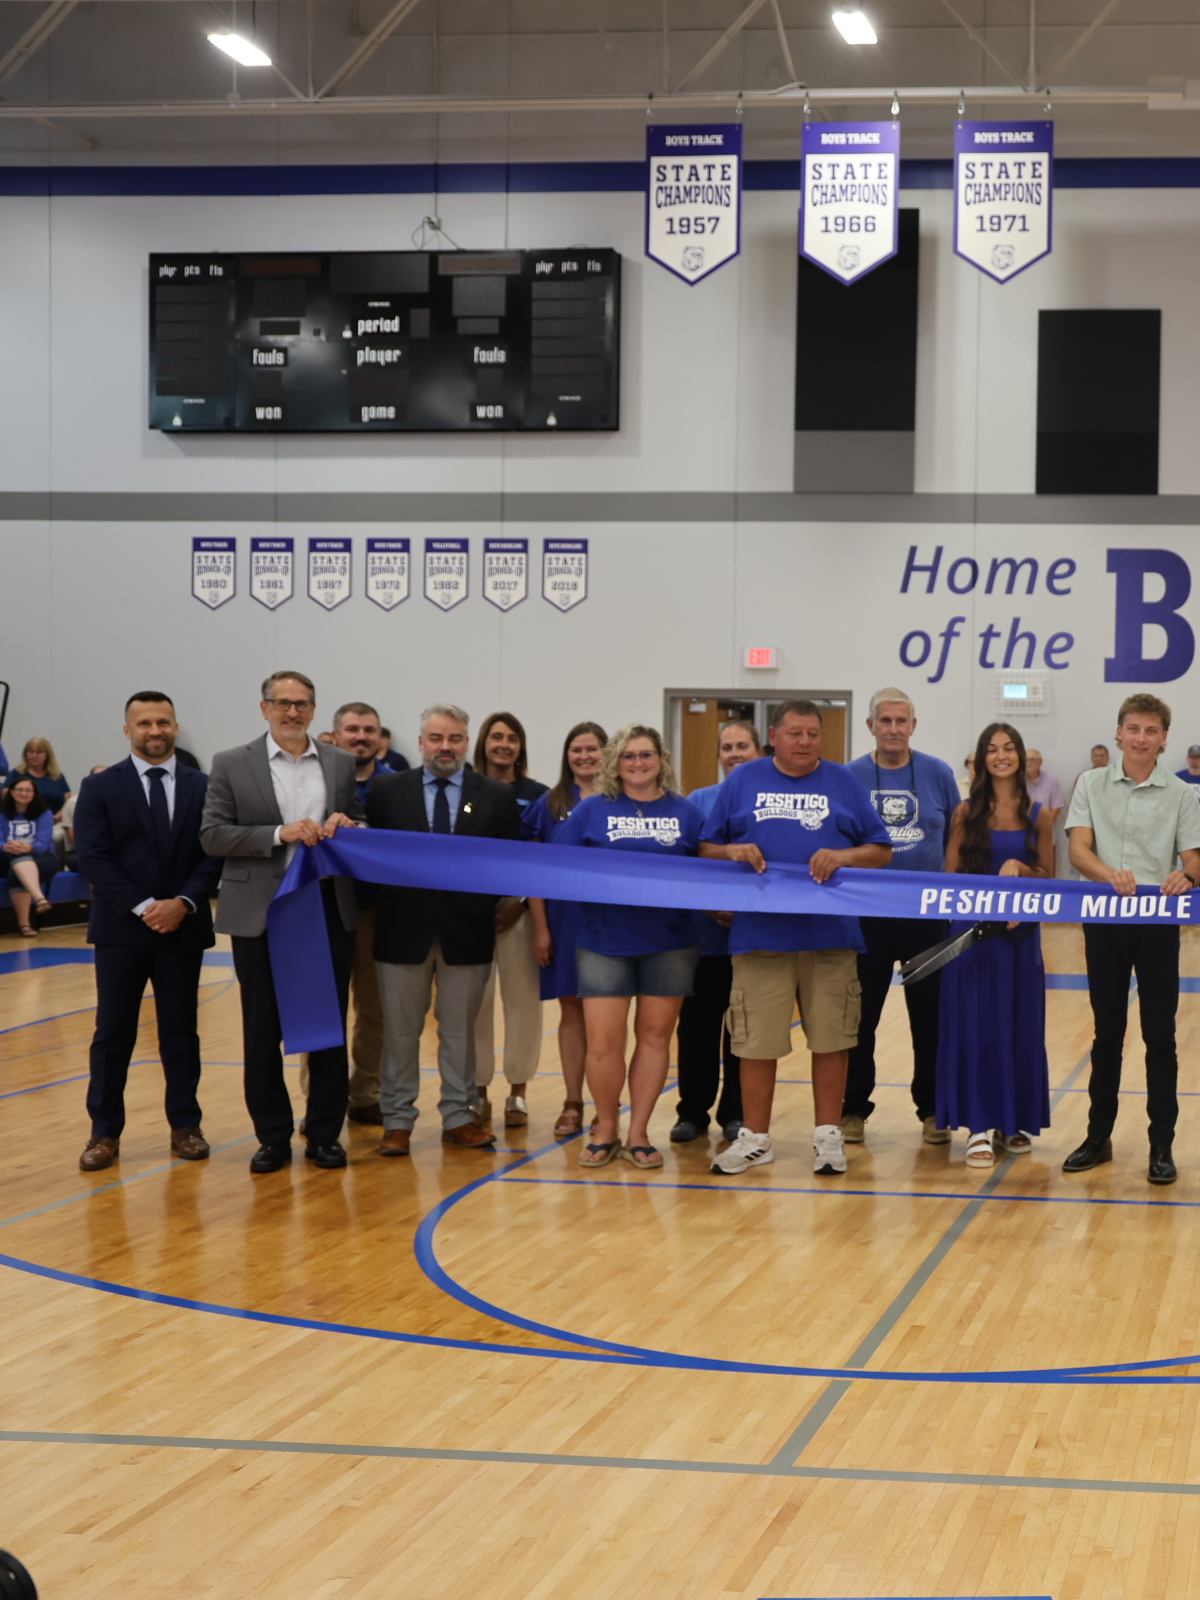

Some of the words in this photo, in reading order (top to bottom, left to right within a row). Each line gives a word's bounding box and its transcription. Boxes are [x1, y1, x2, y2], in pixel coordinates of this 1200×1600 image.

[665, 134, 690, 147] BOYS
[690, 134, 724, 146] TRACK
[821, 133, 845, 145] BOYS
[846, 132, 880, 145] TRACK
[974, 132, 999, 144] BOYS
[1000, 131, 1034, 144] TRACK
[656, 164, 731, 182] STATE
[812, 162, 888, 180] STATE
[965, 161, 1042, 179] STATE
[655, 183, 731, 208] CHAMPIONS
[812, 183, 888, 207] CHAMPIONS
[964, 182, 1042, 206] CHAMPIONS
[665, 216, 720, 235] 1957
[820, 215, 877, 234] 1966
[975, 214, 1030, 233] 1971
[184, 264, 201, 278] pts
[357, 315, 400, 336] period
[252, 348, 285, 366] fouls
[356, 346, 401, 367] player
[473, 346, 506, 363] fouls
[255, 406, 282, 420] won
[361, 406, 396, 423] game
[476, 405, 504, 418] won
[195, 555, 231, 564] STATE
[254, 555, 289, 565] STATE
[311, 555, 347, 565] STATE
[370, 556, 405, 565] STATE
[428, 556, 464, 565] STATE
[487, 556, 523, 566] STATE
[546, 556, 583, 566] STATE
[899, 544, 1077, 596] Home
[898, 615, 966, 684] of
[978, 616, 1075, 670] the
[755, 792, 829, 809] PESHTIGO
[757, 808, 798, 818] BULLDOGS
[607, 815, 680, 830] PESHTIGO
[920, 888, 1062, 916] PESHTIGO
[1081, 894, 1192, 919] MIDDLE
